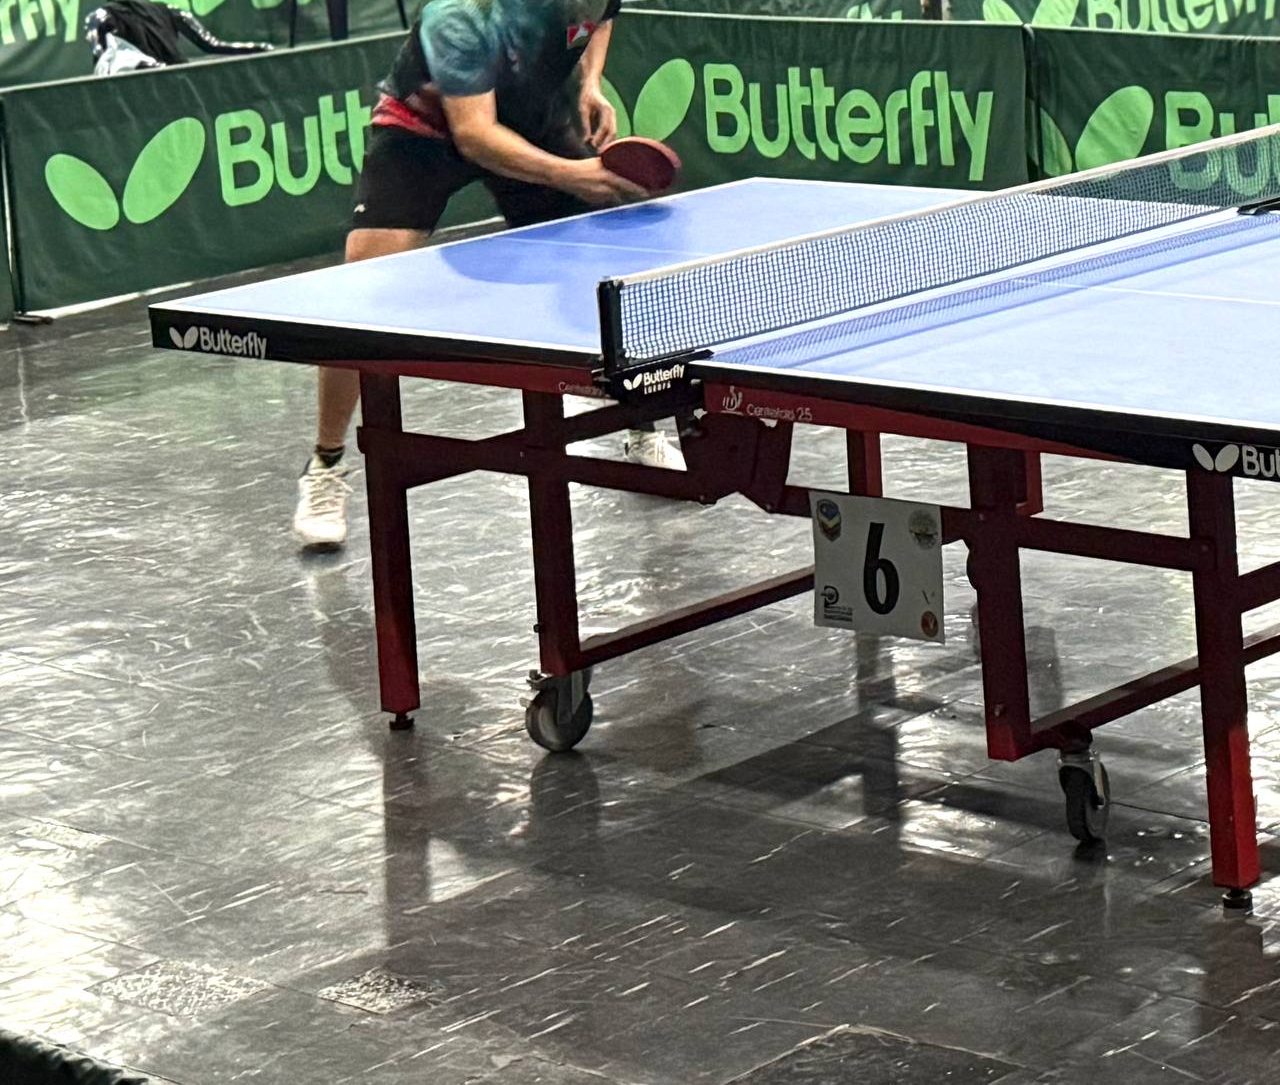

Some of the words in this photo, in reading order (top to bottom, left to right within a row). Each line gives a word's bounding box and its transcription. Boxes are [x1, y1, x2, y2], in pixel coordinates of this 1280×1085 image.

[704, 64, 993, 181] Butterfly
[199, 326, 267, 359] Butterfly
[643, 364, 685, 386] Butterfly
[863, 522, 900, 615] 6
